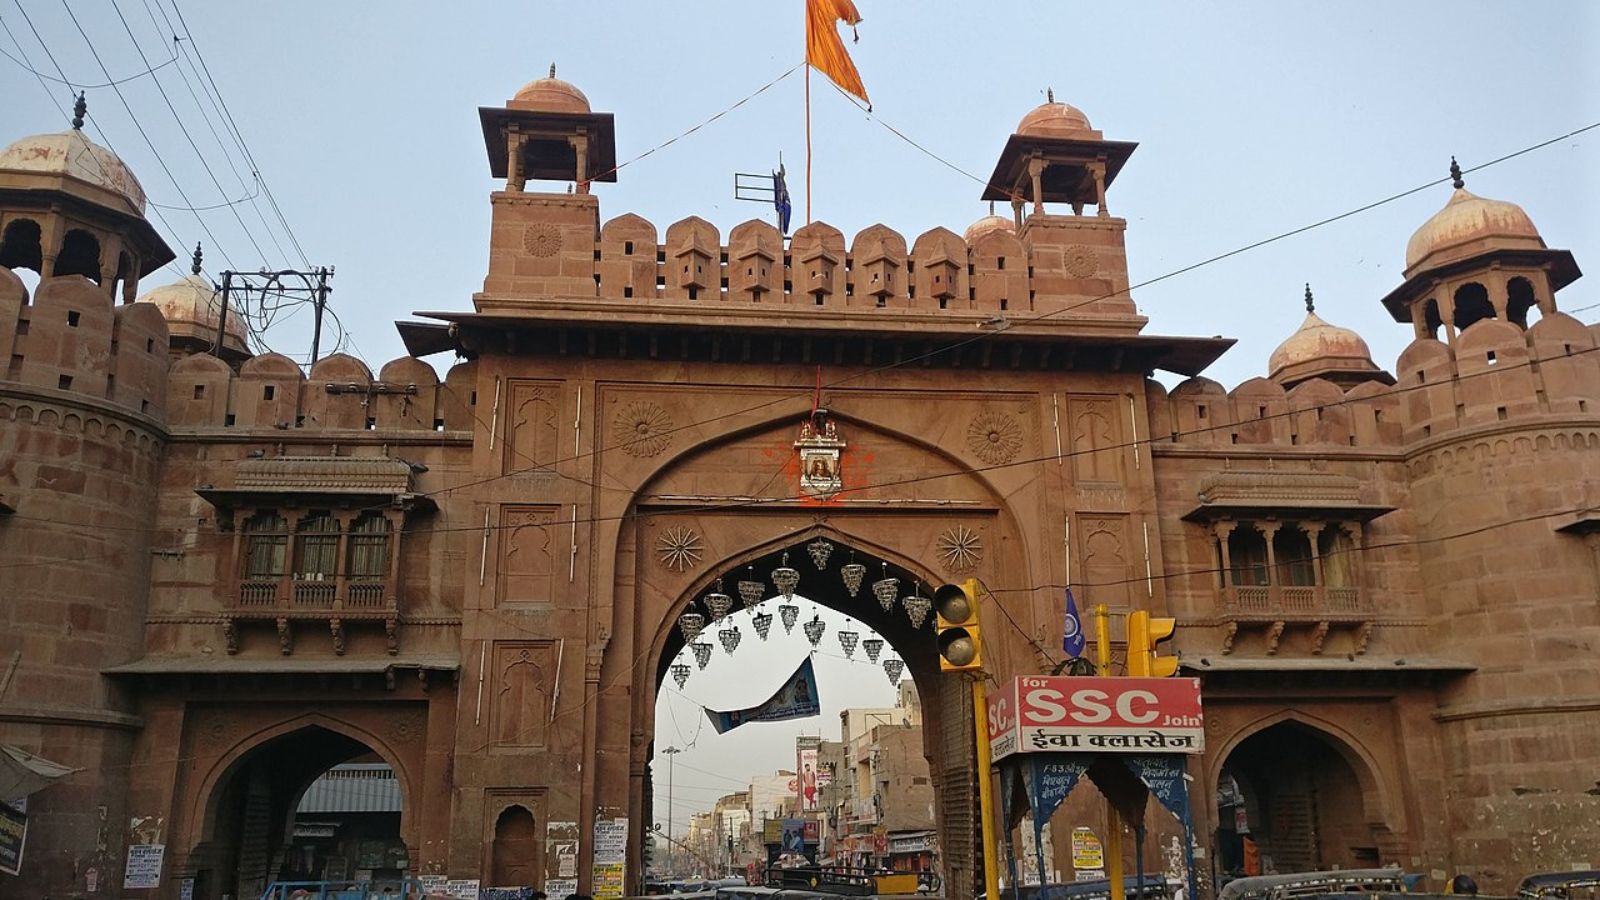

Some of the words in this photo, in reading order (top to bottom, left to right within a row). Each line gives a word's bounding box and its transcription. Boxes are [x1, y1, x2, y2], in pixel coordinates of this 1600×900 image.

[1023, 677, 1048, 687] for
[988, 698, 1007, 736] SC
[1024, 689, 1160, 724] SSC
[1163, 715, 1200, 726] Join
[1030, 728, 1081, 749] ईवा
[1088, 730, 1195, 748] क्लासेज
